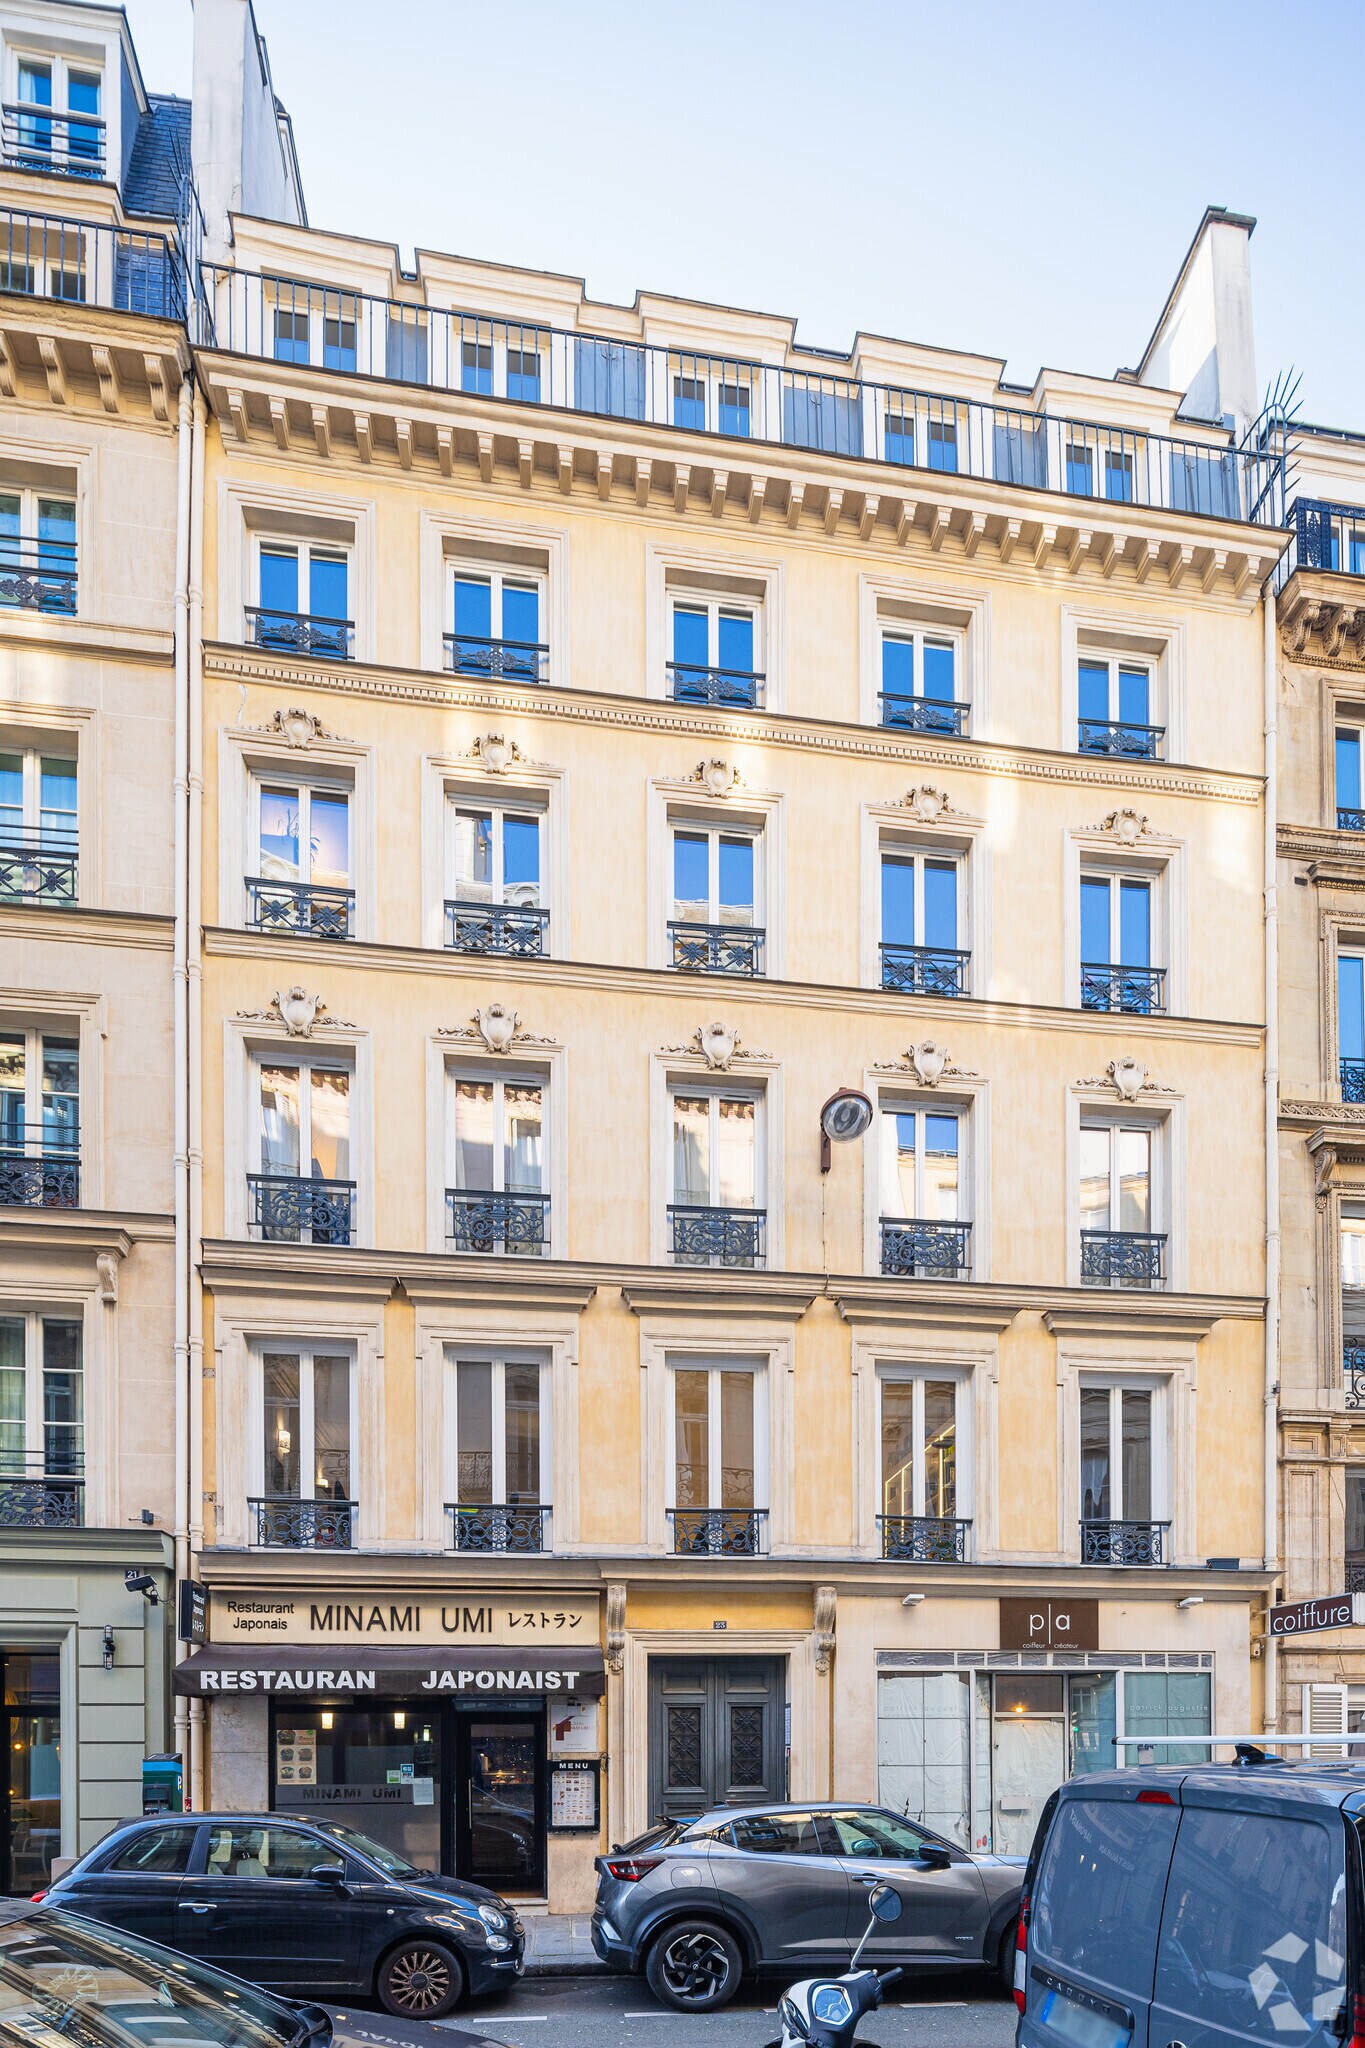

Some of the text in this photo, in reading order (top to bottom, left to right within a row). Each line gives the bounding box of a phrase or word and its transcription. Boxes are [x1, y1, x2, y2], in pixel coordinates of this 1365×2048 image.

[127, 1570, 137, 1579] 21
[227, 1601, 295, 1614] Restaurant
[233, 1617, 288, 1632] Japonais
[310, 1604, 493, 1633] MINAMI UMI
[507, 1612, 583, 1629] レストラン
[1273, 1602, 1350, 1632] coiffure
[1022, 1641, 1046, 1649] coiffeur
[200, 1670, 580, 1690] RESTAURAN JAPONAIST
[302, 1788, 361, 1799] MINAMI
[372, 1787, 401, 1799] UMI
